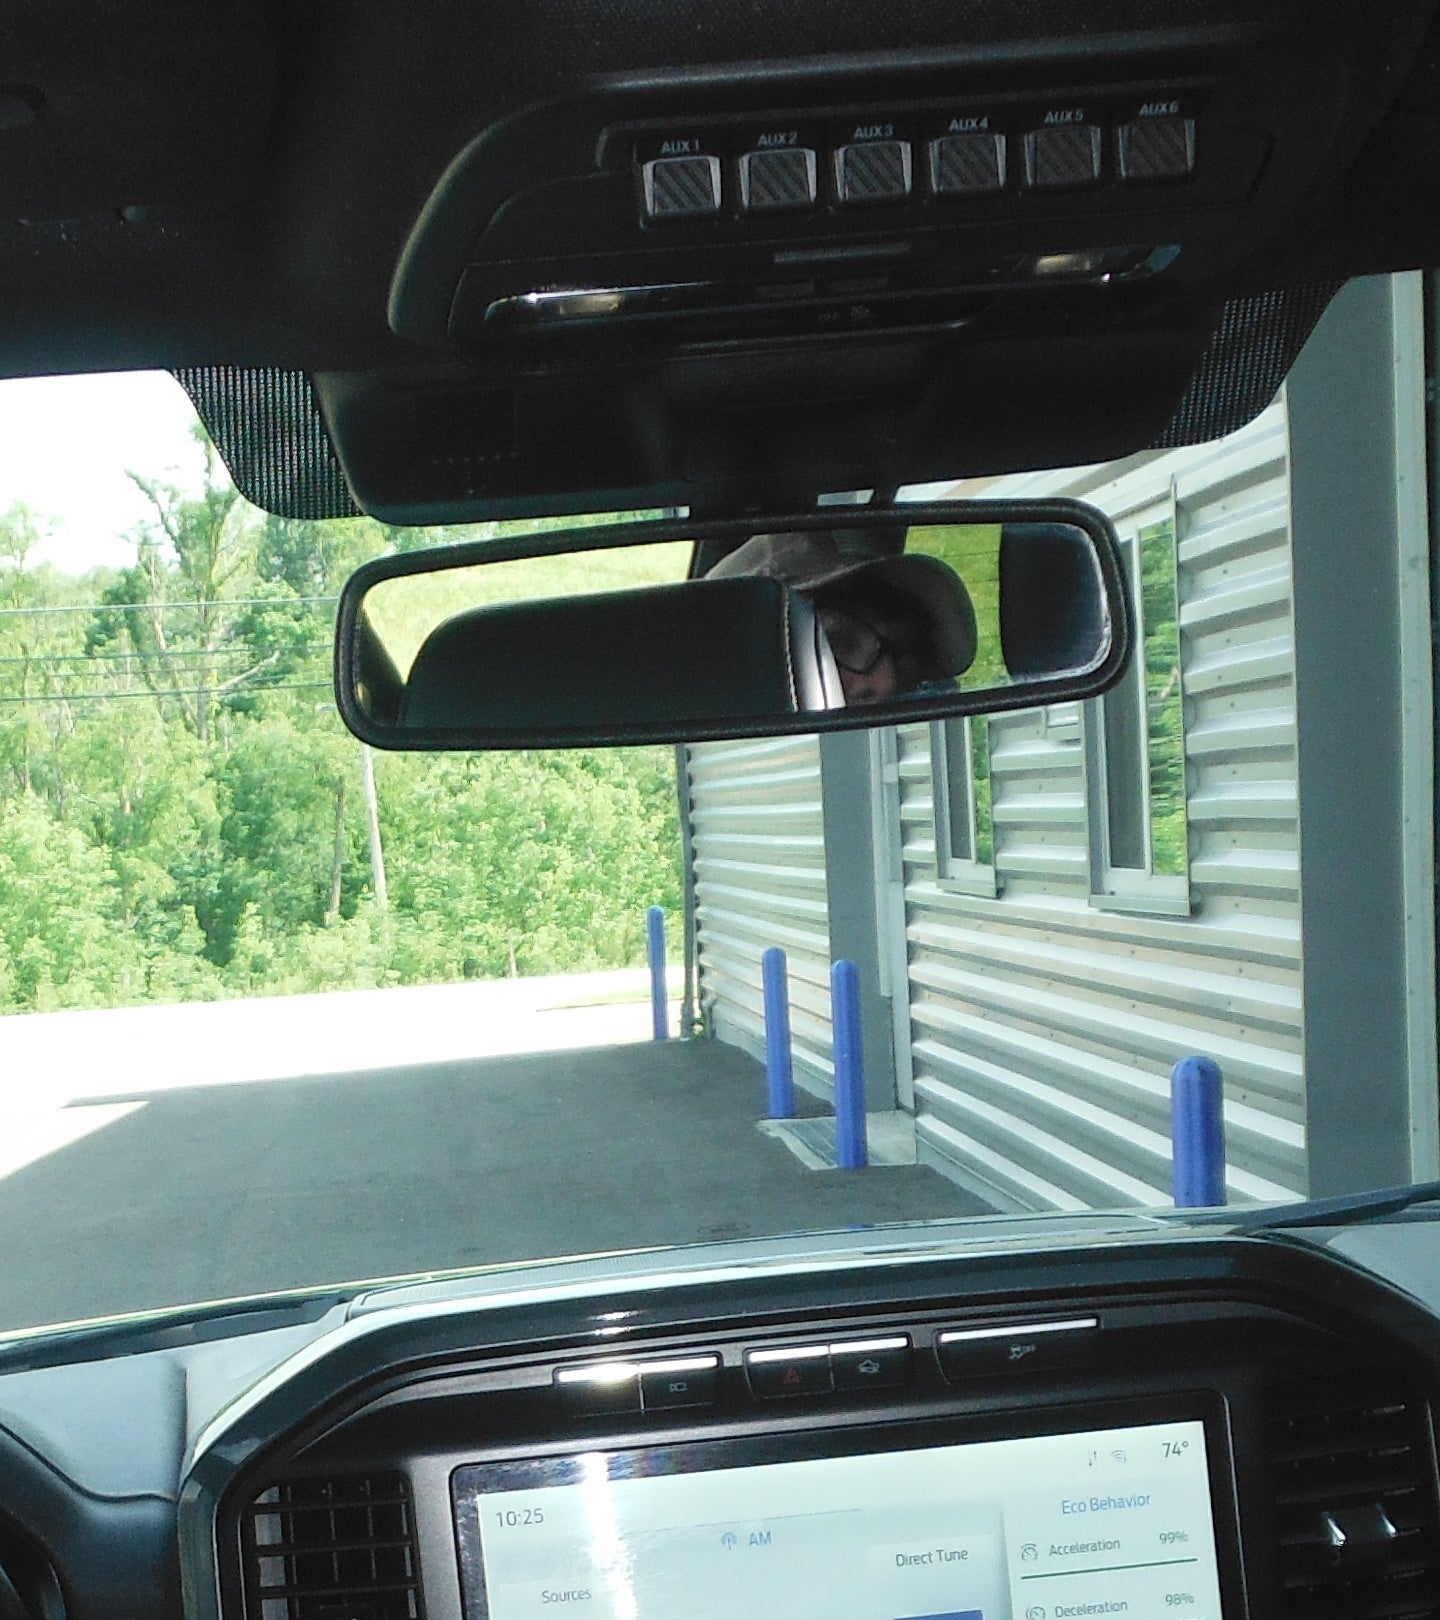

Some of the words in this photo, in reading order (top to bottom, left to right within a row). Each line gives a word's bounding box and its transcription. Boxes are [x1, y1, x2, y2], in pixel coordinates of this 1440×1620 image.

[1061, 1499, 1087, 1515] Eco
[1089, 1493, 1151, 1512] Behavior
[496, 1507, 545, 1528] 10:25
[749, 1531, 773, 1546] AM
[1159, 1530, 1189, 1544] 99%
[1048, 1538, 1121, 1557] Acceleration
[895, 1550, 934, 1567] Direct
[936, 1548, 969, 1563] Tune
[541, 1588, 592, 1604] Sources
[1055, 1599, 1128, 1618] Deceleration
